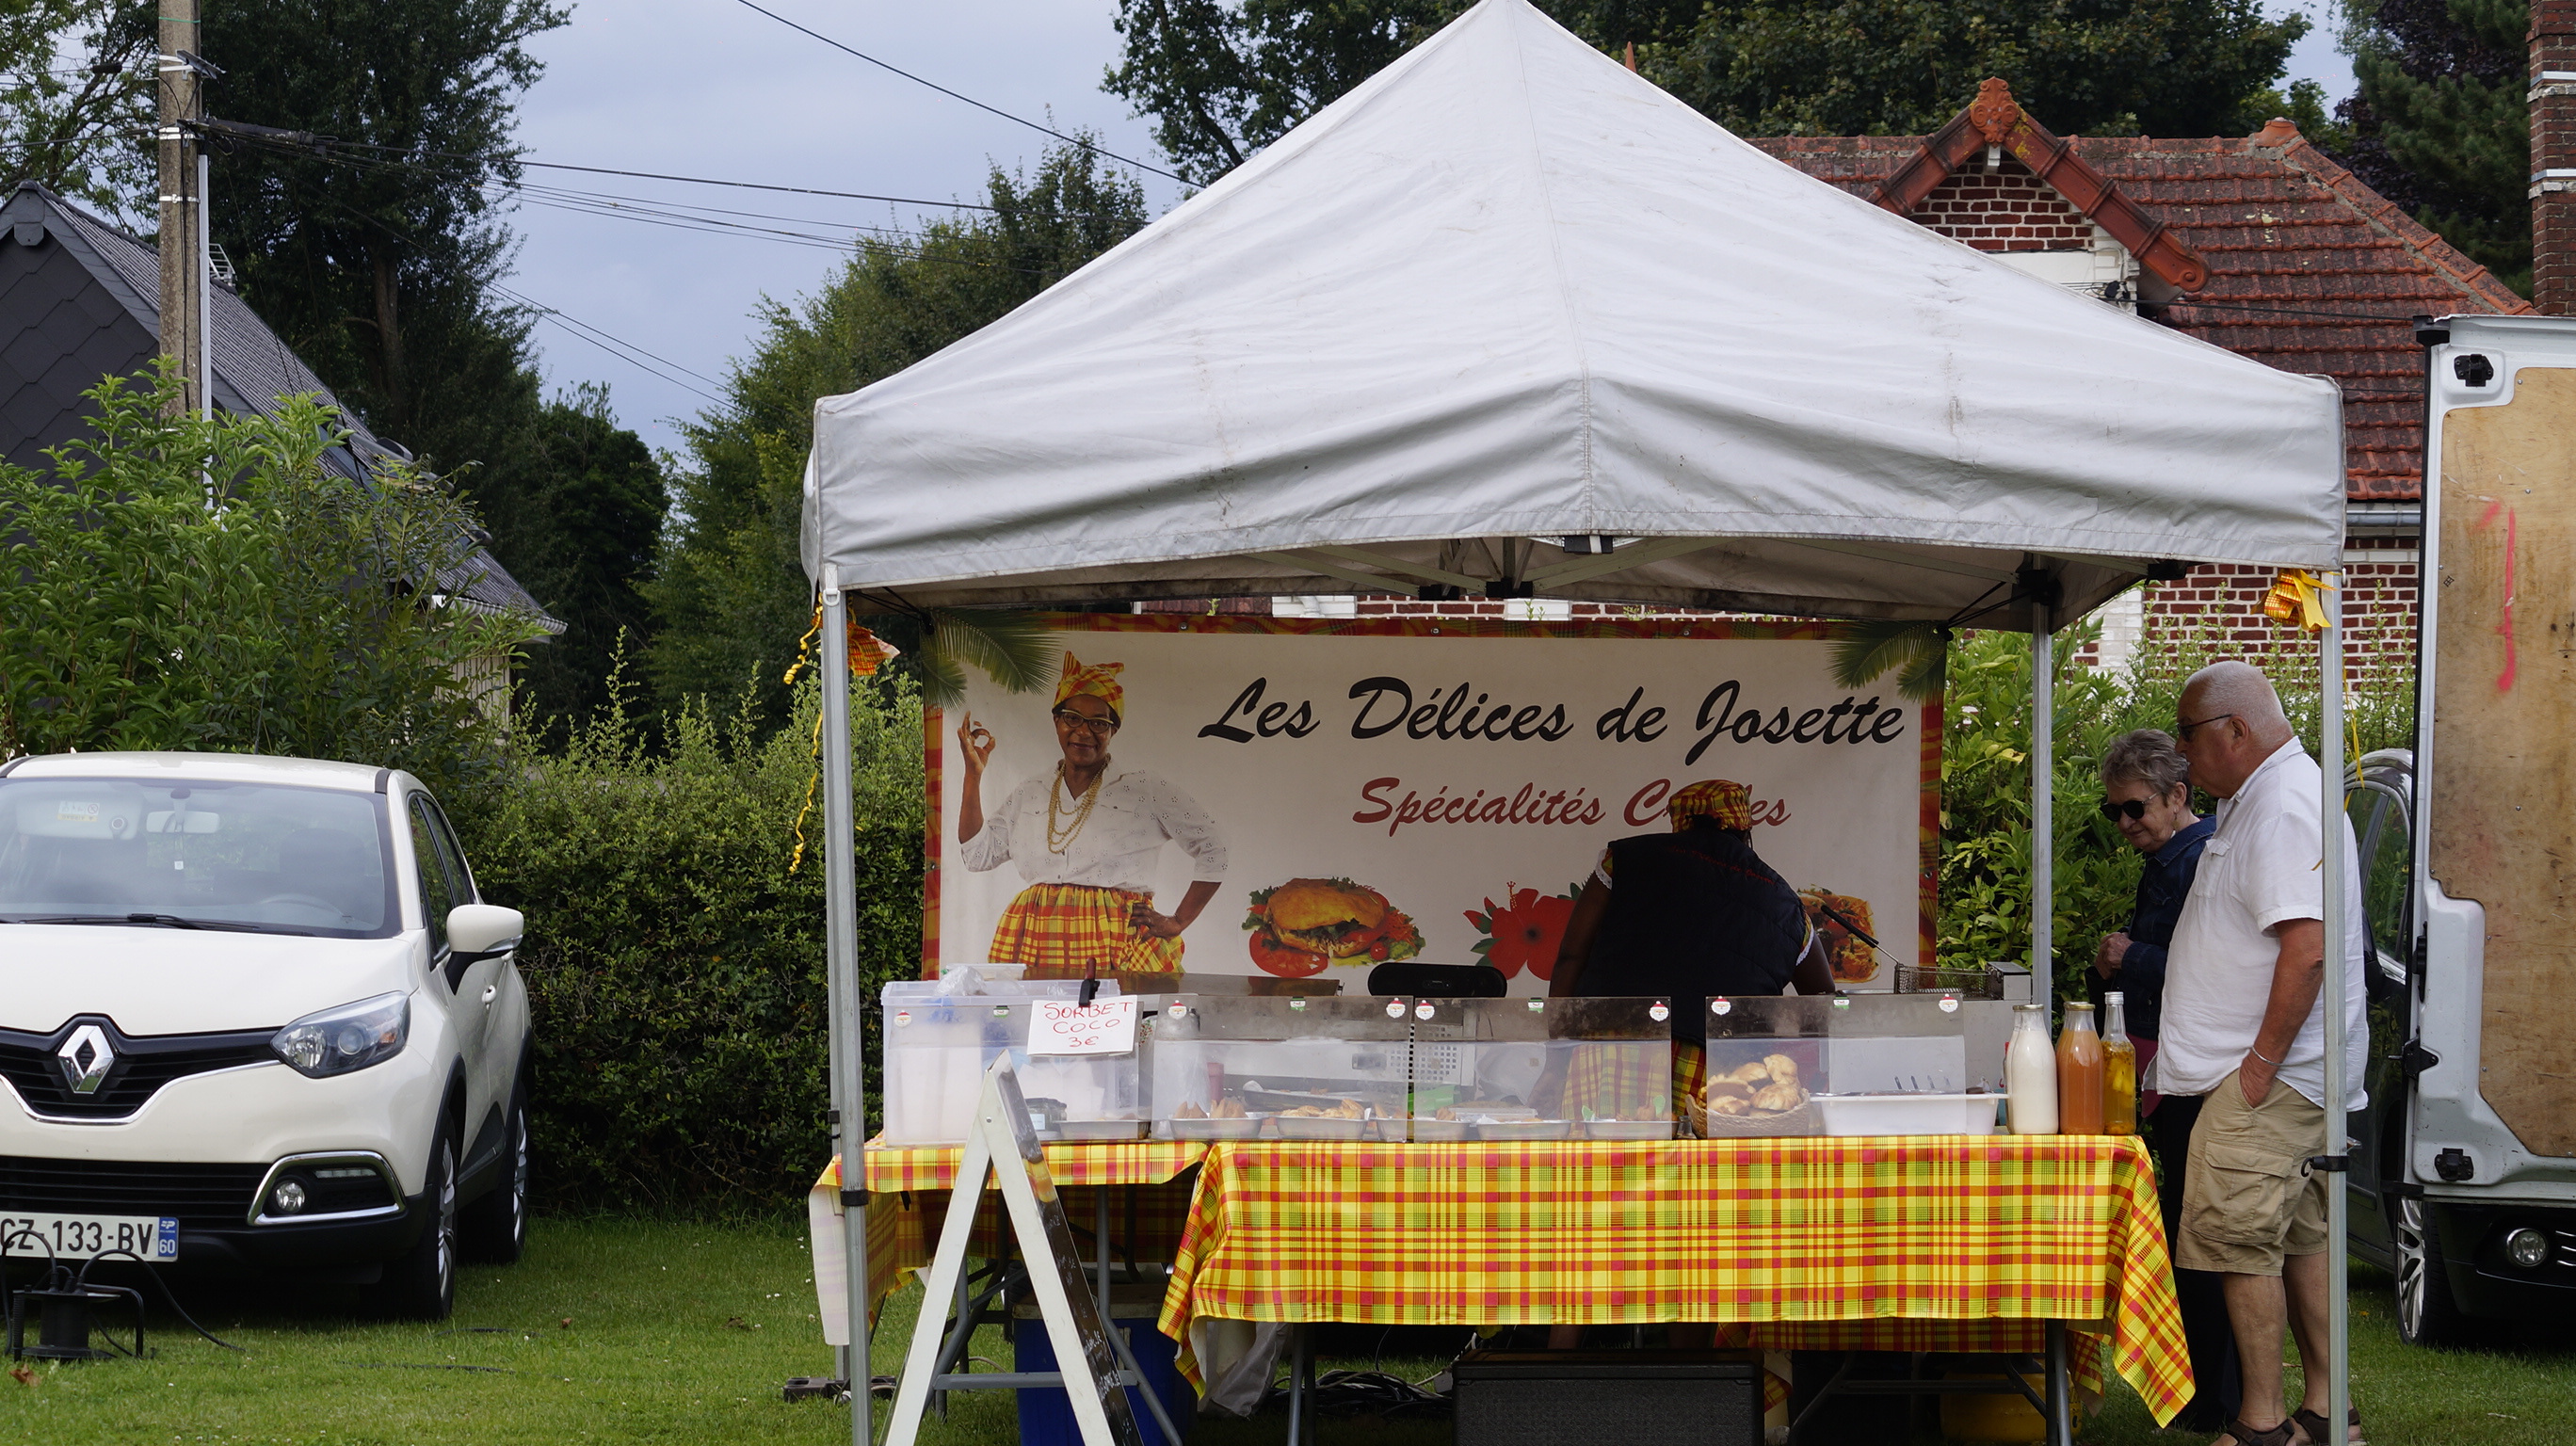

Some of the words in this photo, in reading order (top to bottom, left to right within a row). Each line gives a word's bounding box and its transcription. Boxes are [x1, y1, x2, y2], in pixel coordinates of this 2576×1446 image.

[1197, 677, 1321, 744] Les
[1348, 676, 1574, 742] Délices
[1596, 685, 1668, 743] de
[1684, 680, 1905, 766] Josette
[1352, 777, 1606, 837] Spécialités
[1044, 1002, 1134, 1020] SORBET
[1053, 1019, 1120, 1035] COCO
[1069, 1036, 1099, 1048] 3€
[159, 1239, 176, 1254] 60
